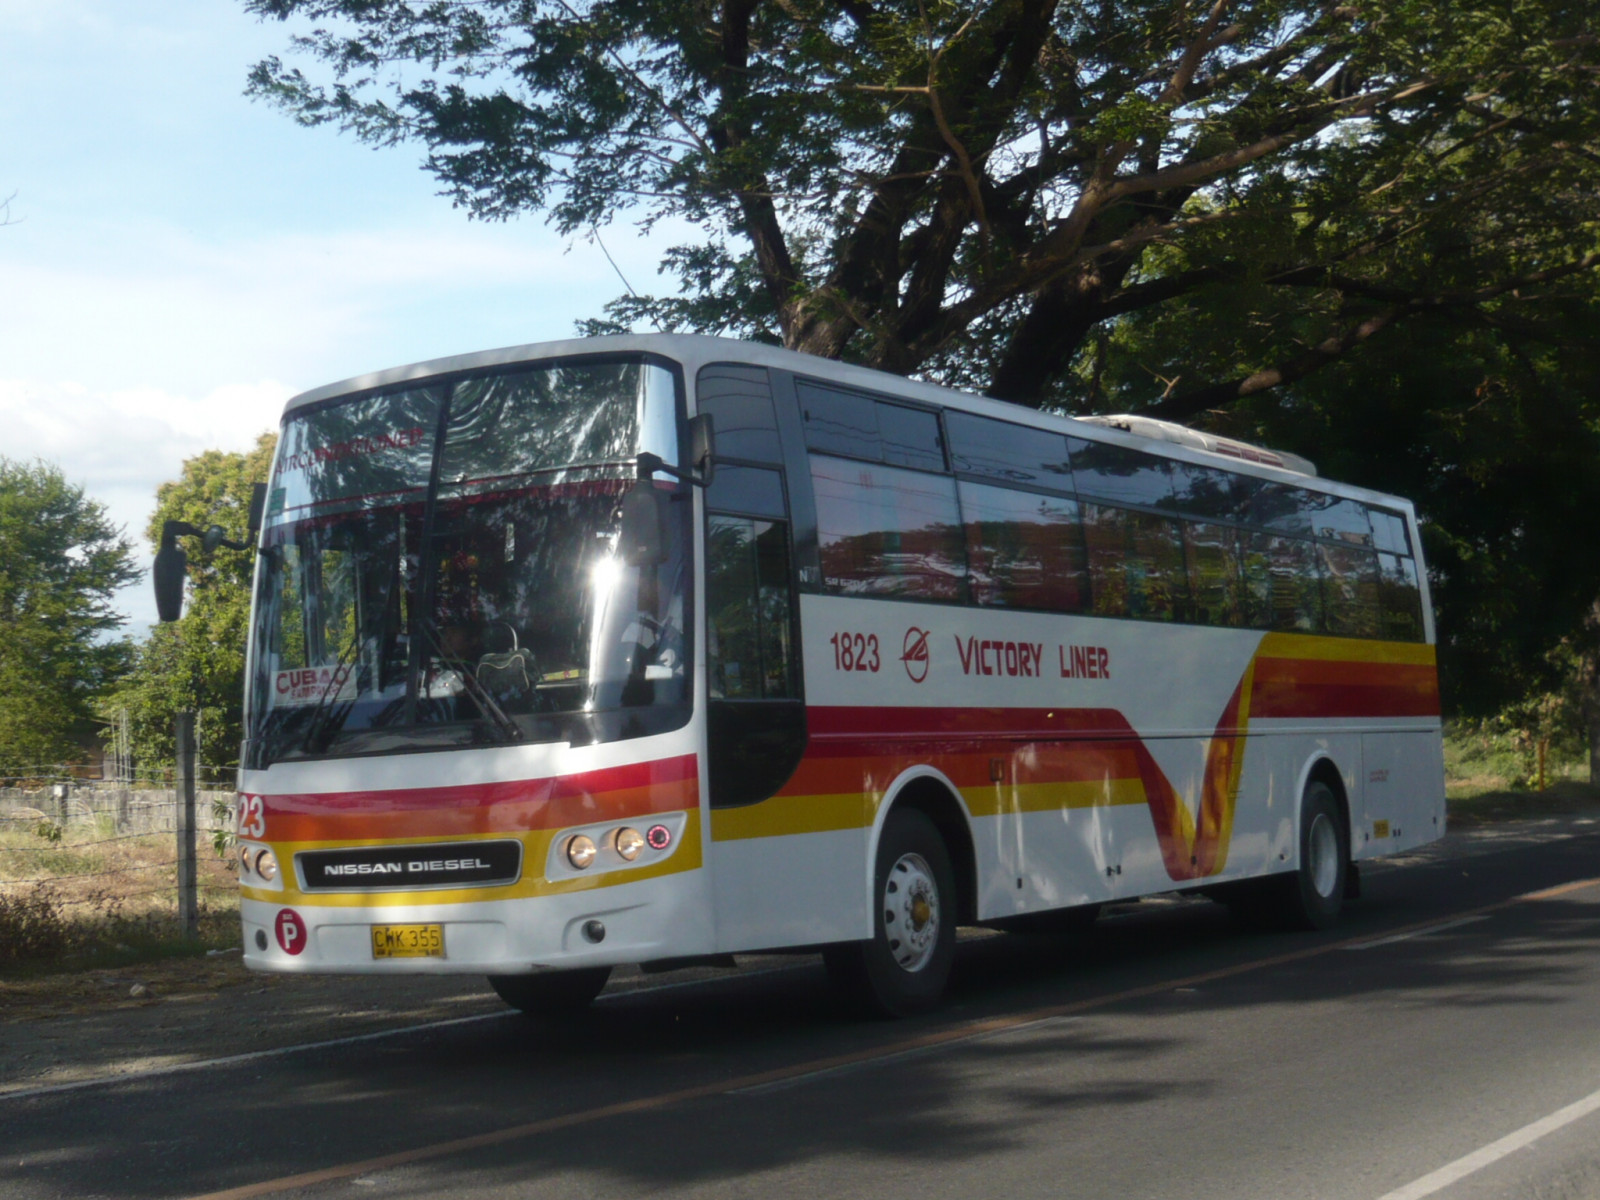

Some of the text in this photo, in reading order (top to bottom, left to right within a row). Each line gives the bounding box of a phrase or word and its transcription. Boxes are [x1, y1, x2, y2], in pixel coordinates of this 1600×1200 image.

[830, 632, 881, 672] 1823
[954, 634, 1111, 679] VICTORY LINER
[324, 858, 491, 876] NISSAN DIESEL
[374, 929, 440, 948] CWK 355
